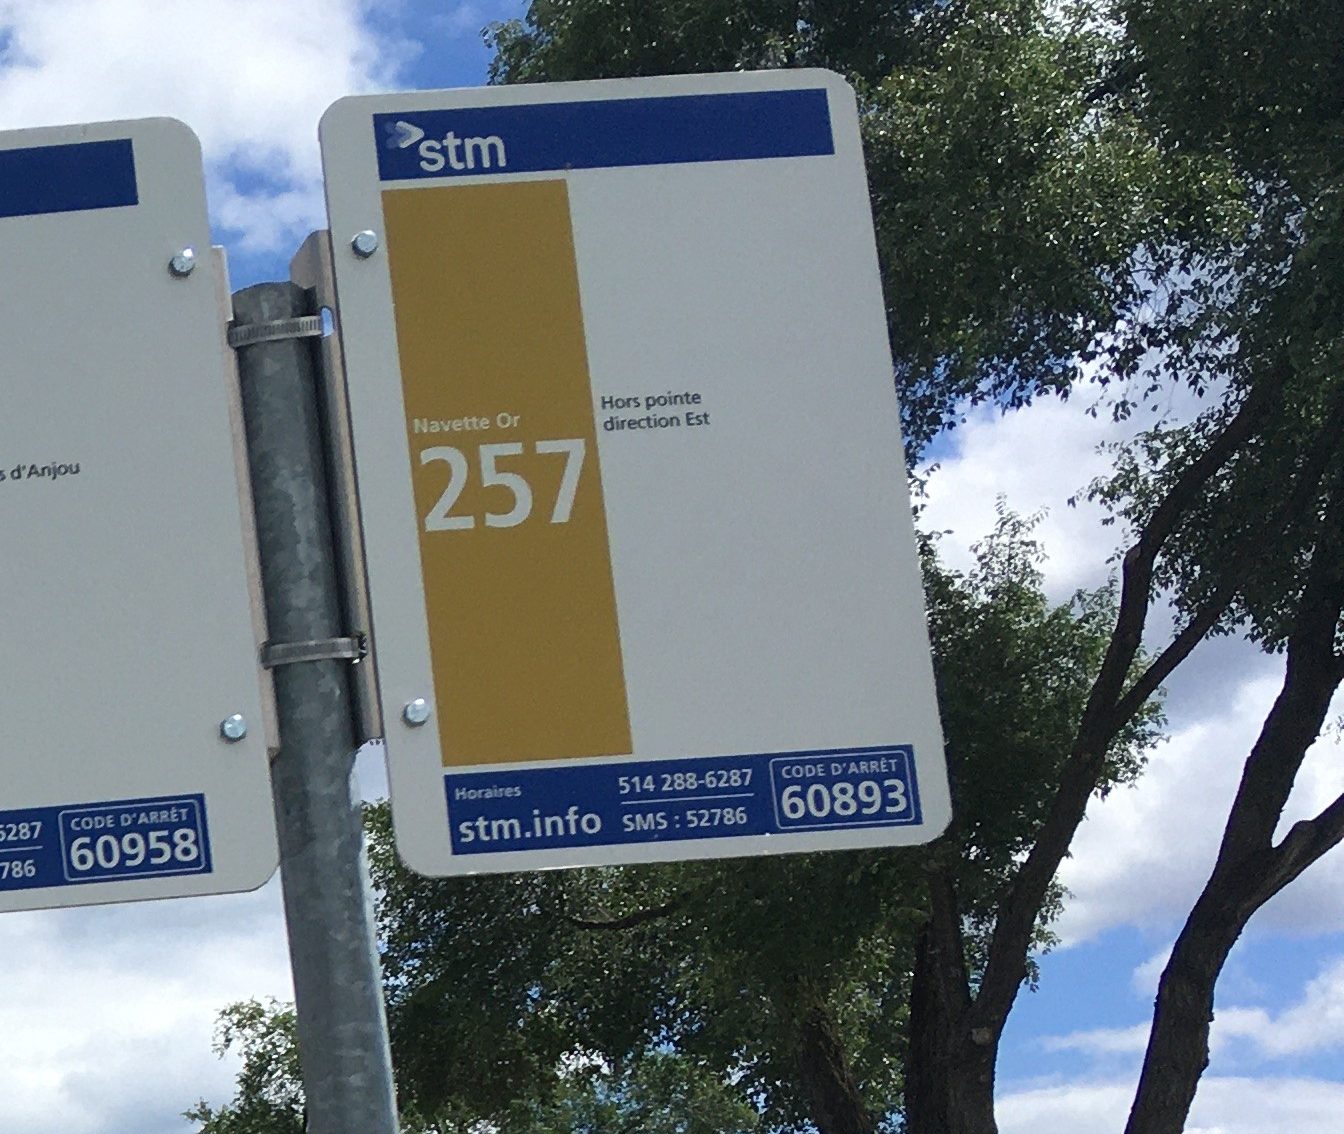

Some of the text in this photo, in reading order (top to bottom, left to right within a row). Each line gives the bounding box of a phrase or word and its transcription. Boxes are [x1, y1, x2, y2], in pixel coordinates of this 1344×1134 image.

[419, 131, 506, 172] stm
[600, 391, 702, 410] Hors pointe
[414, 412, 521, 435] Navette Or
[603, 411, 711, 432] direction Est
[10, 459, 81, 483] d'Anjou
[419, 438, 587, 532] 257
[782, 758, 898, 779] CODE D'ARRÊT
[455, 783, 522, 801] Horaires
[619, 768, 754, 795] 514 288-6287
[781, 778, 906, 820] 60893
[70, 807, 188, 831] CODE D'ARRÊT
[459, 805, 602, 844] stm.info
[622, 813, 670, 833] SMS
[686, 806, 747, 828] 52786
[70, 828, 198, 872] 60958
